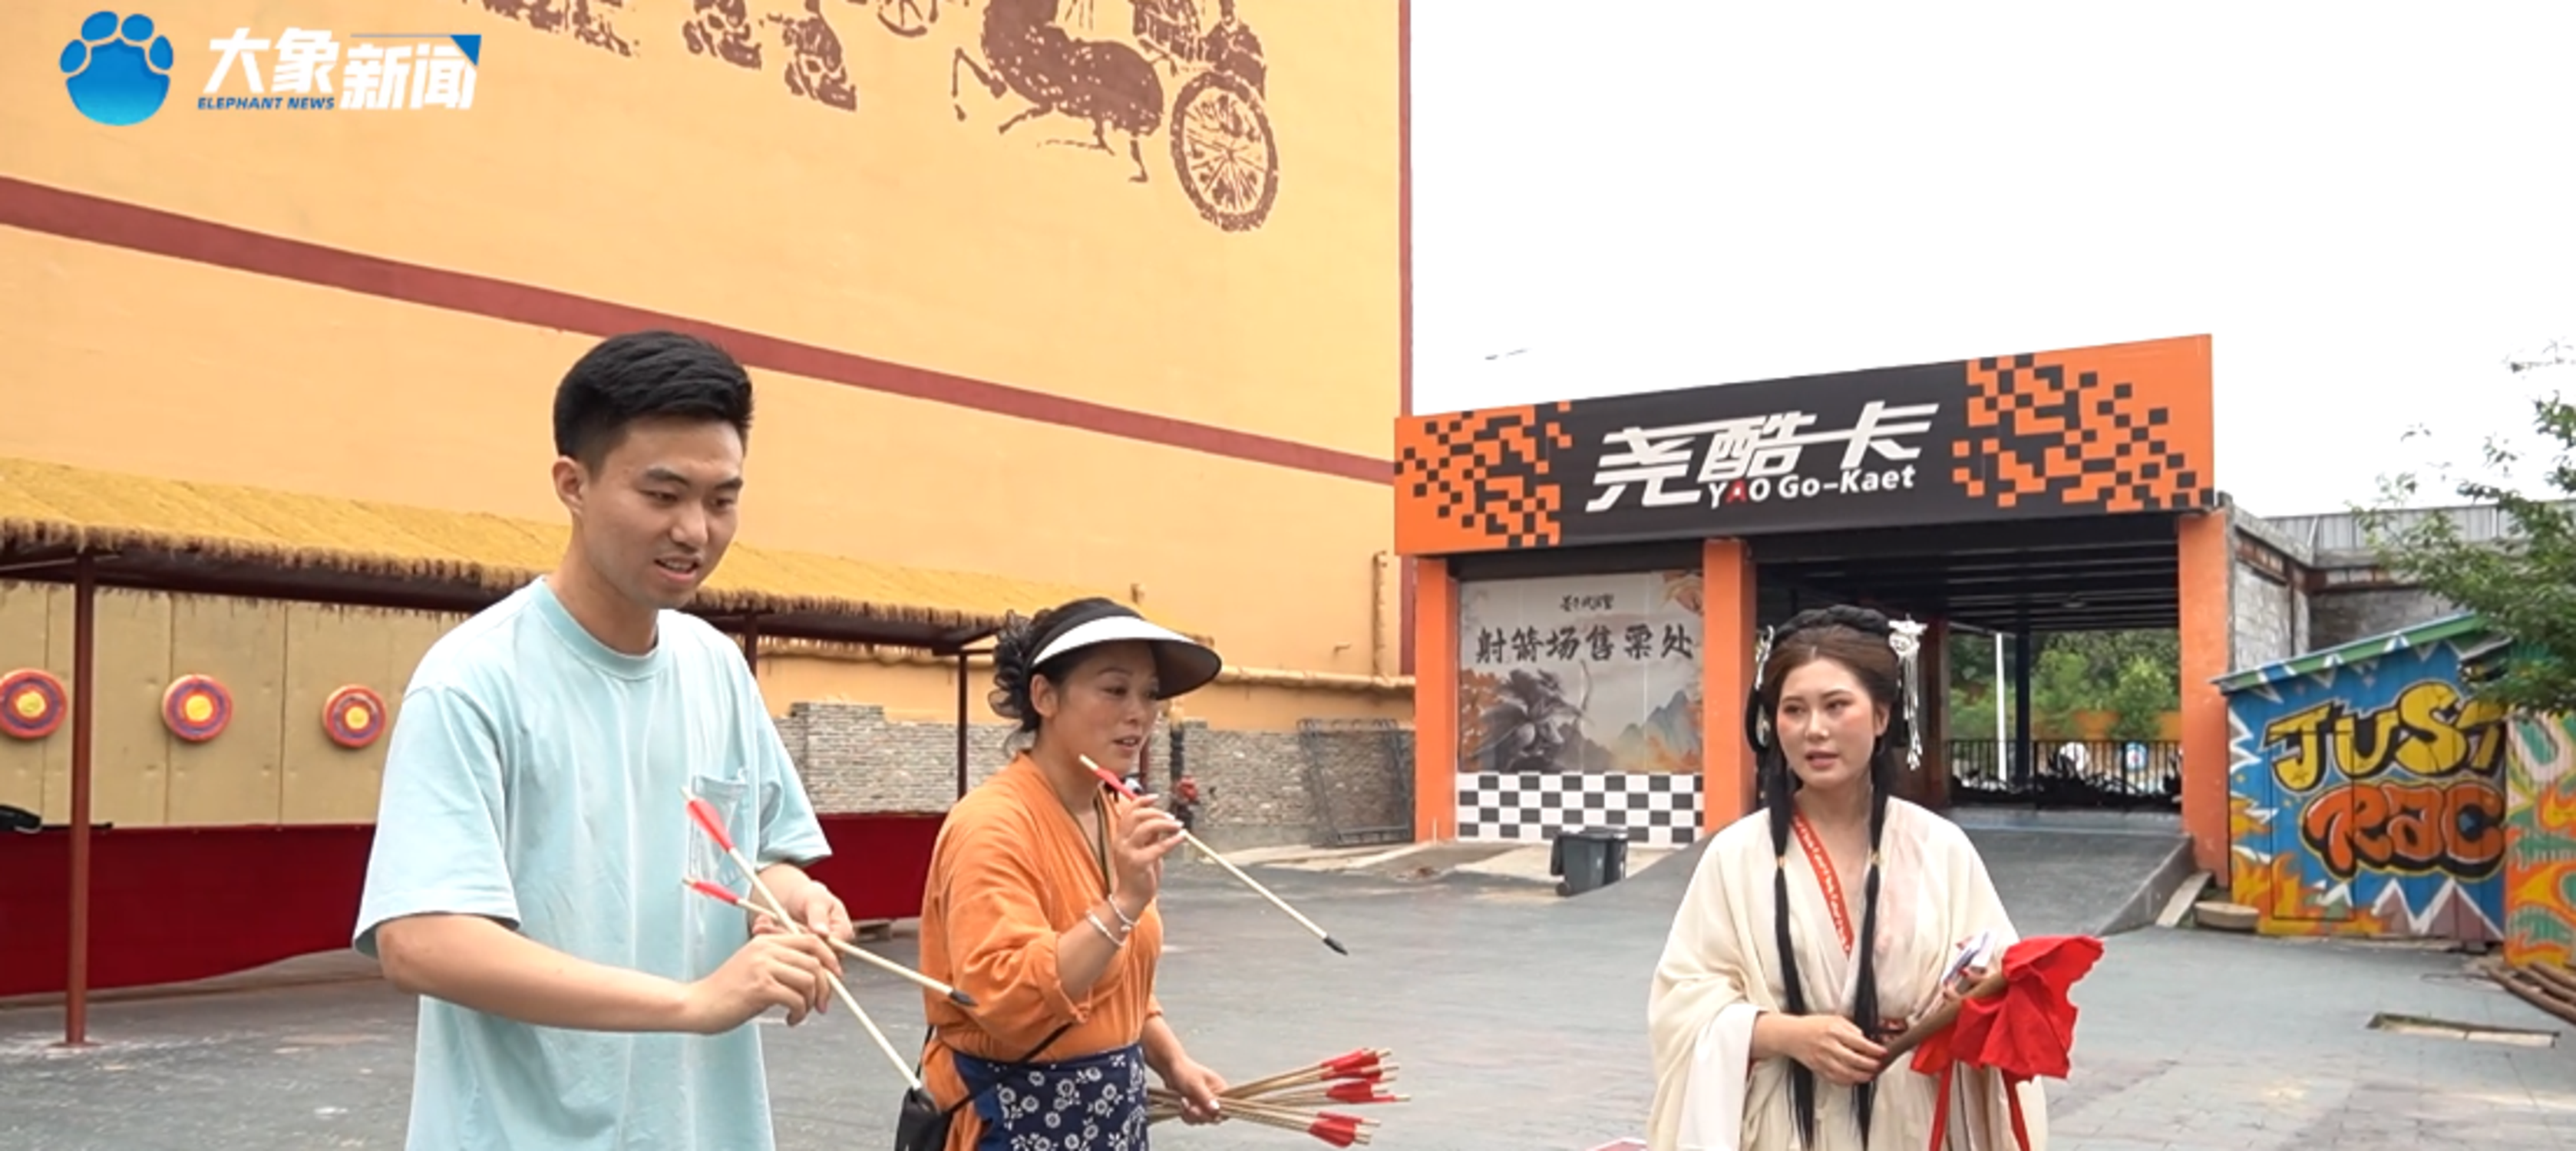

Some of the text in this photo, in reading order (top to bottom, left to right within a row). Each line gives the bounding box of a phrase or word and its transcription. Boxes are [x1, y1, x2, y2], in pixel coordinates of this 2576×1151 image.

[1585, 401, 1940, 513] 尧酷卡
[1708, 464, 1917, 510] YAO Go-Kaet
[1475, 623, 1693, 664] 射箭场售票处
